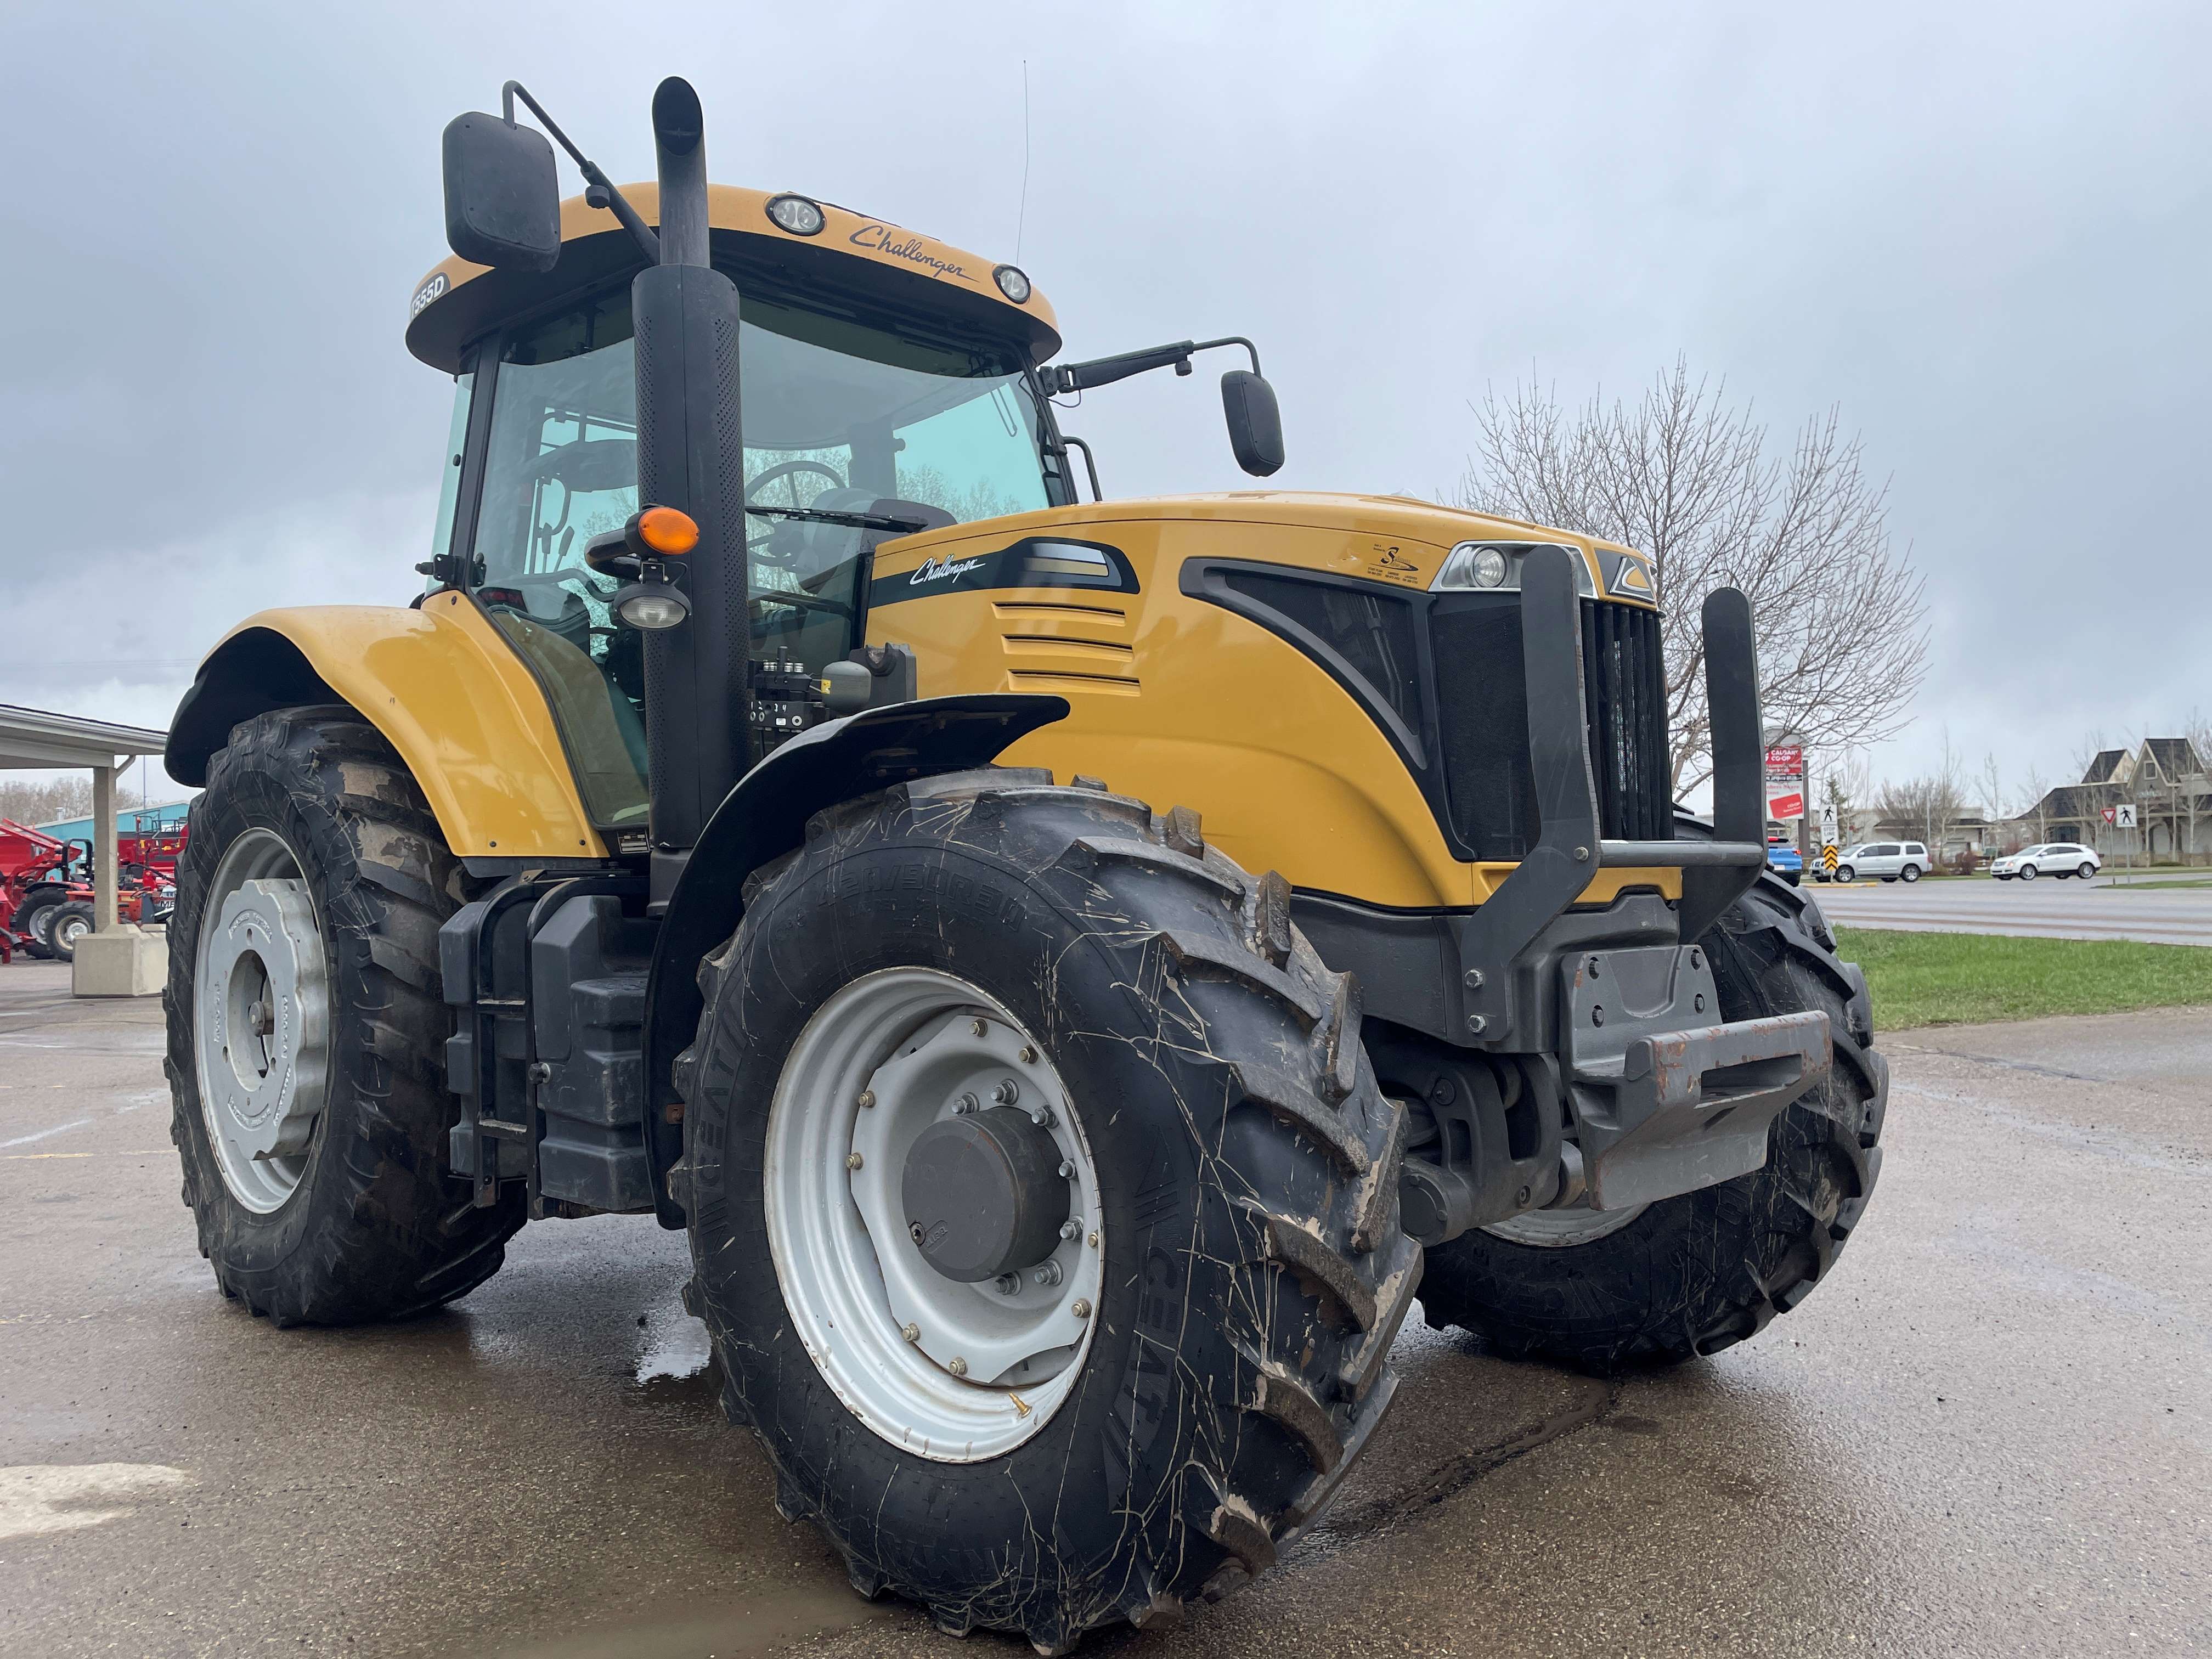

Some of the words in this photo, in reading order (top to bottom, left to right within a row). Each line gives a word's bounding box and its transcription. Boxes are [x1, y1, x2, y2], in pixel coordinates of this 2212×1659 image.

[849, 225, 980, 283] Challenger
[909, 554, 986, 585] Challenger
[1124, 1245, 1178, 1424] CEAT
